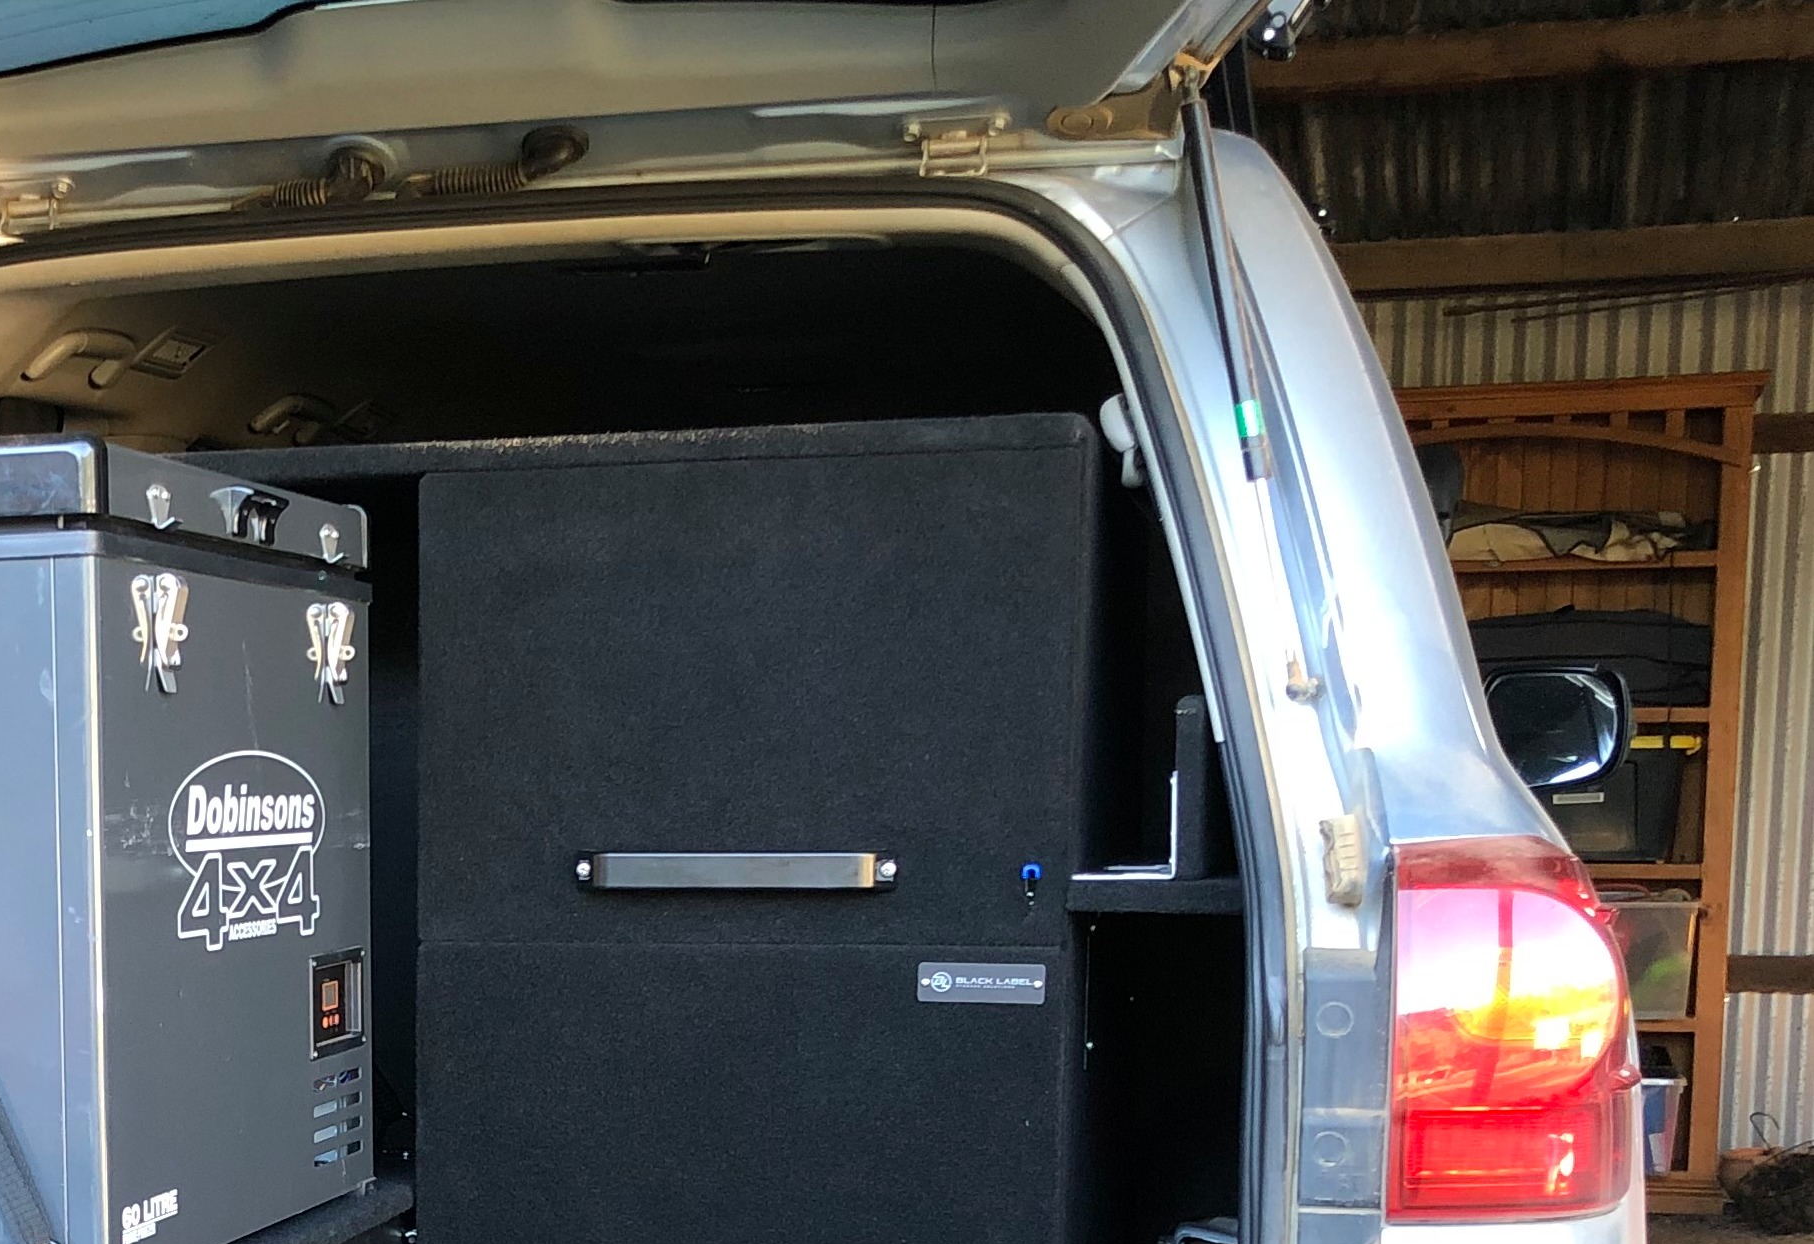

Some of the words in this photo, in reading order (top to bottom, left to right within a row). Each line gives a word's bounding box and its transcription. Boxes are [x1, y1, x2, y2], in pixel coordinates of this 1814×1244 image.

[186, 783, 315, 836] Dobinsons
[177, 845, 320, 951] 4x4
[955, 977, 993, 985] BLACK
[996, 978, 1033, 986] LABEL
[122, 1203, 140, 1230] 60
[143, 1189, 178, 1222] LITRE
